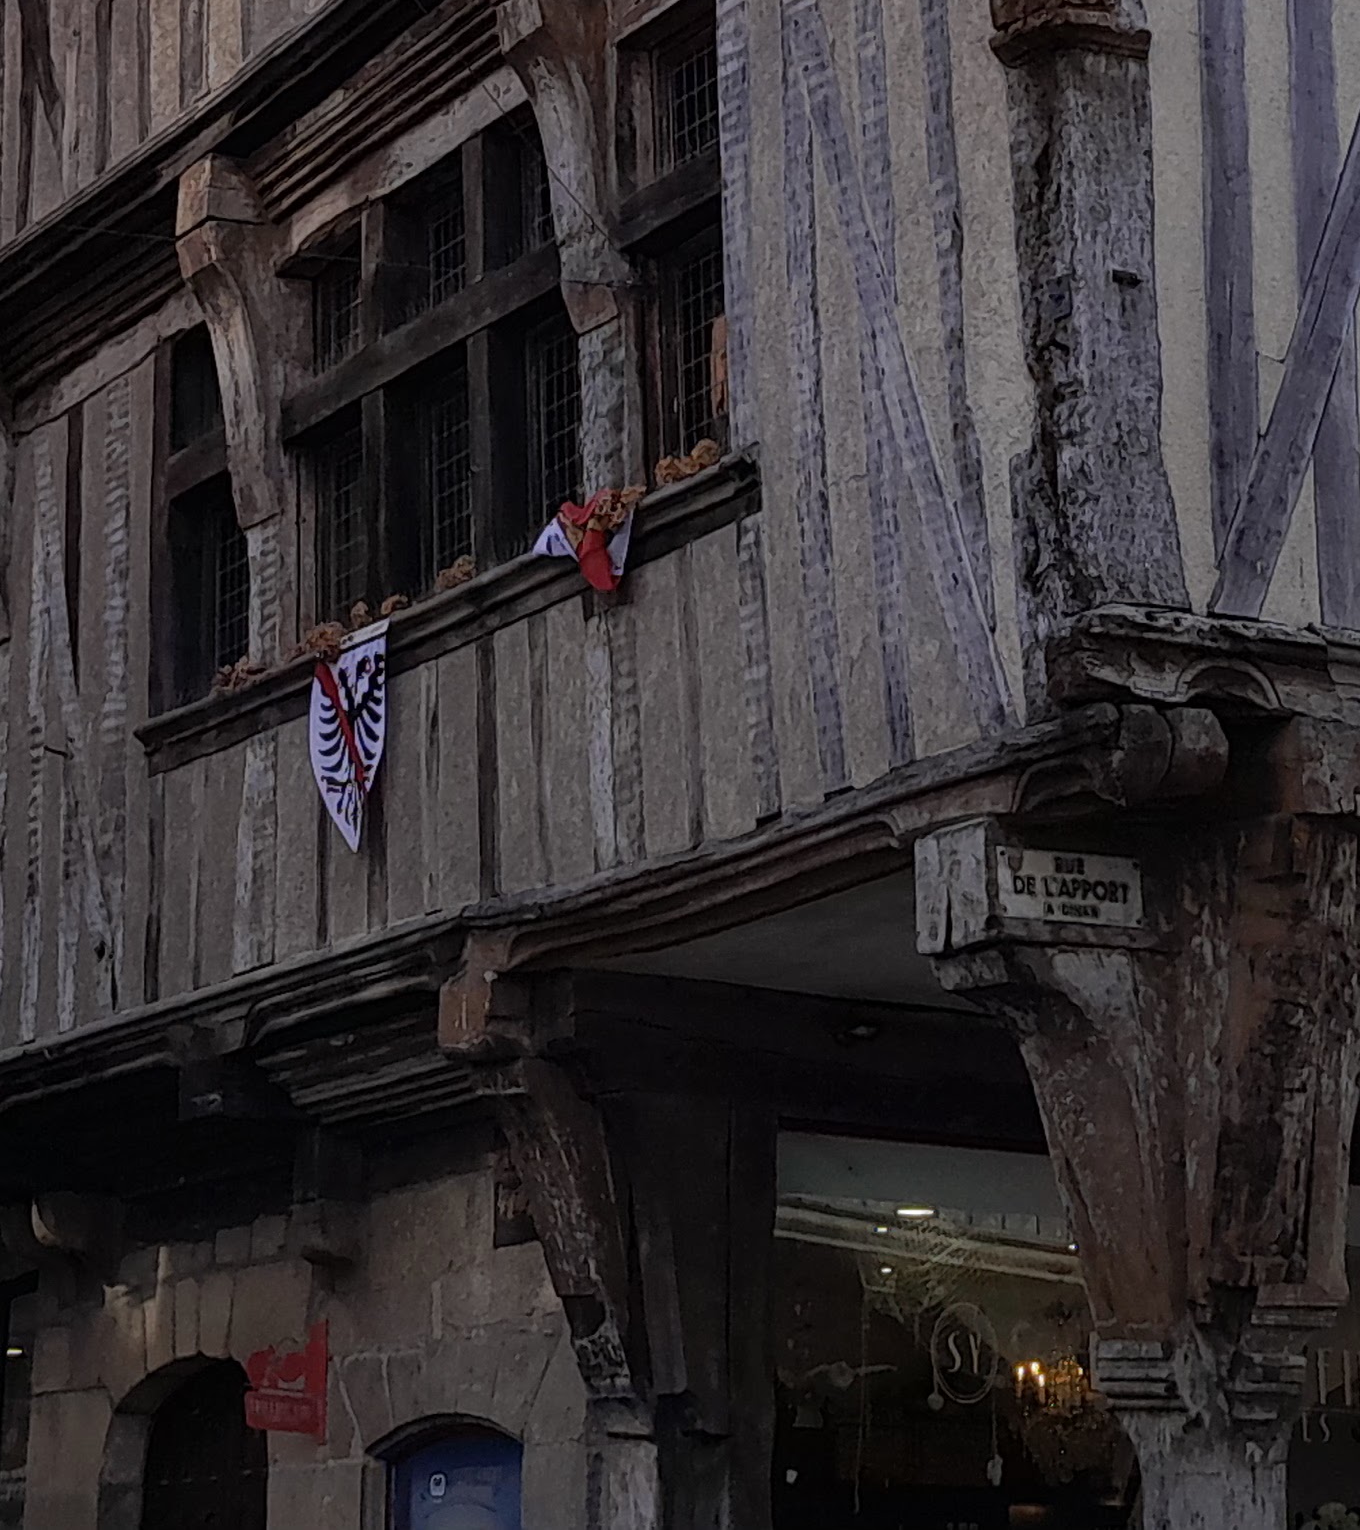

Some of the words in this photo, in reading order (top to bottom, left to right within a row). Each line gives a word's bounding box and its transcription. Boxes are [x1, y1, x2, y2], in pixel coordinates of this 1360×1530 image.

[1054, 856, 1085, 875] RUE
[1013, 875, 1036, 896] DE
[1043, 876, 1129, 904] L'APPORT
[946, 1330, 982, 1375] SY
